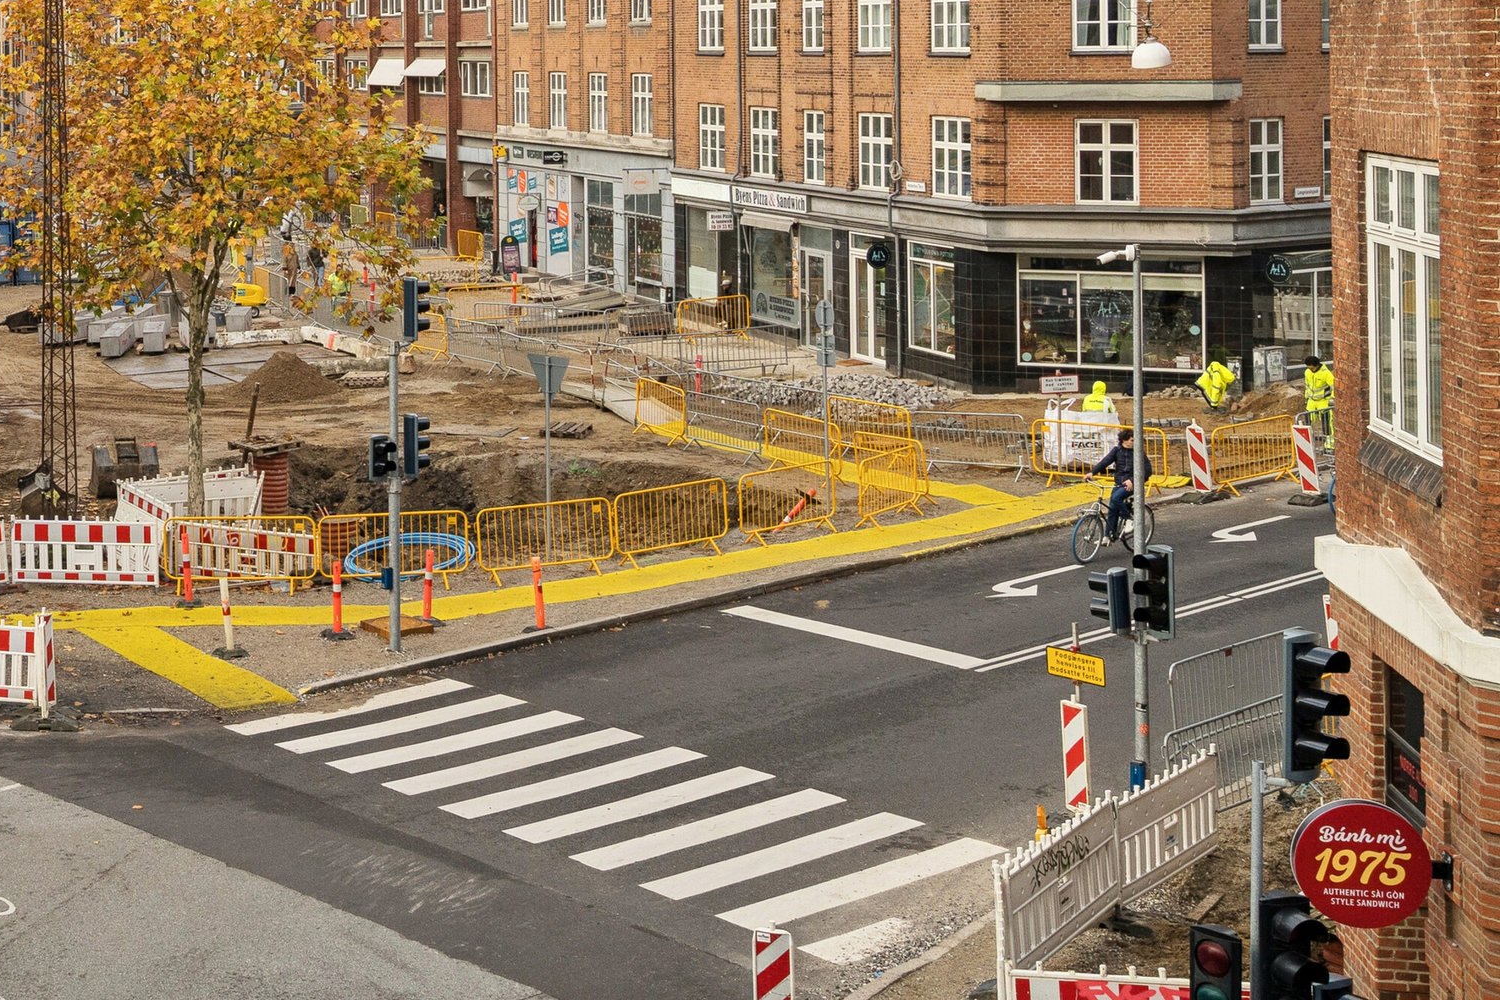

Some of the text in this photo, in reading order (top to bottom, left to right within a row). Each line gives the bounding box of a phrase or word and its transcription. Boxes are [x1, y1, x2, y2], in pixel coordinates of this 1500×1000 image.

[735, 188, 805, 211] Byens Pizza & Sandwich
[1055, 651, 1096, 665] Fodgængere
[1056, 660, 1086, 671] henvises
[1049, 666, 1102, 682] modsatte fortov
[1319, 825, 1407, 851] Bánh mì
[1314, 848, 1412, 886] 1975
[1323, 887, 1405, 899] AUTHENTIC SÀI GÒN
[1330, 897, 1400, 909] STYLE SANDWICH
